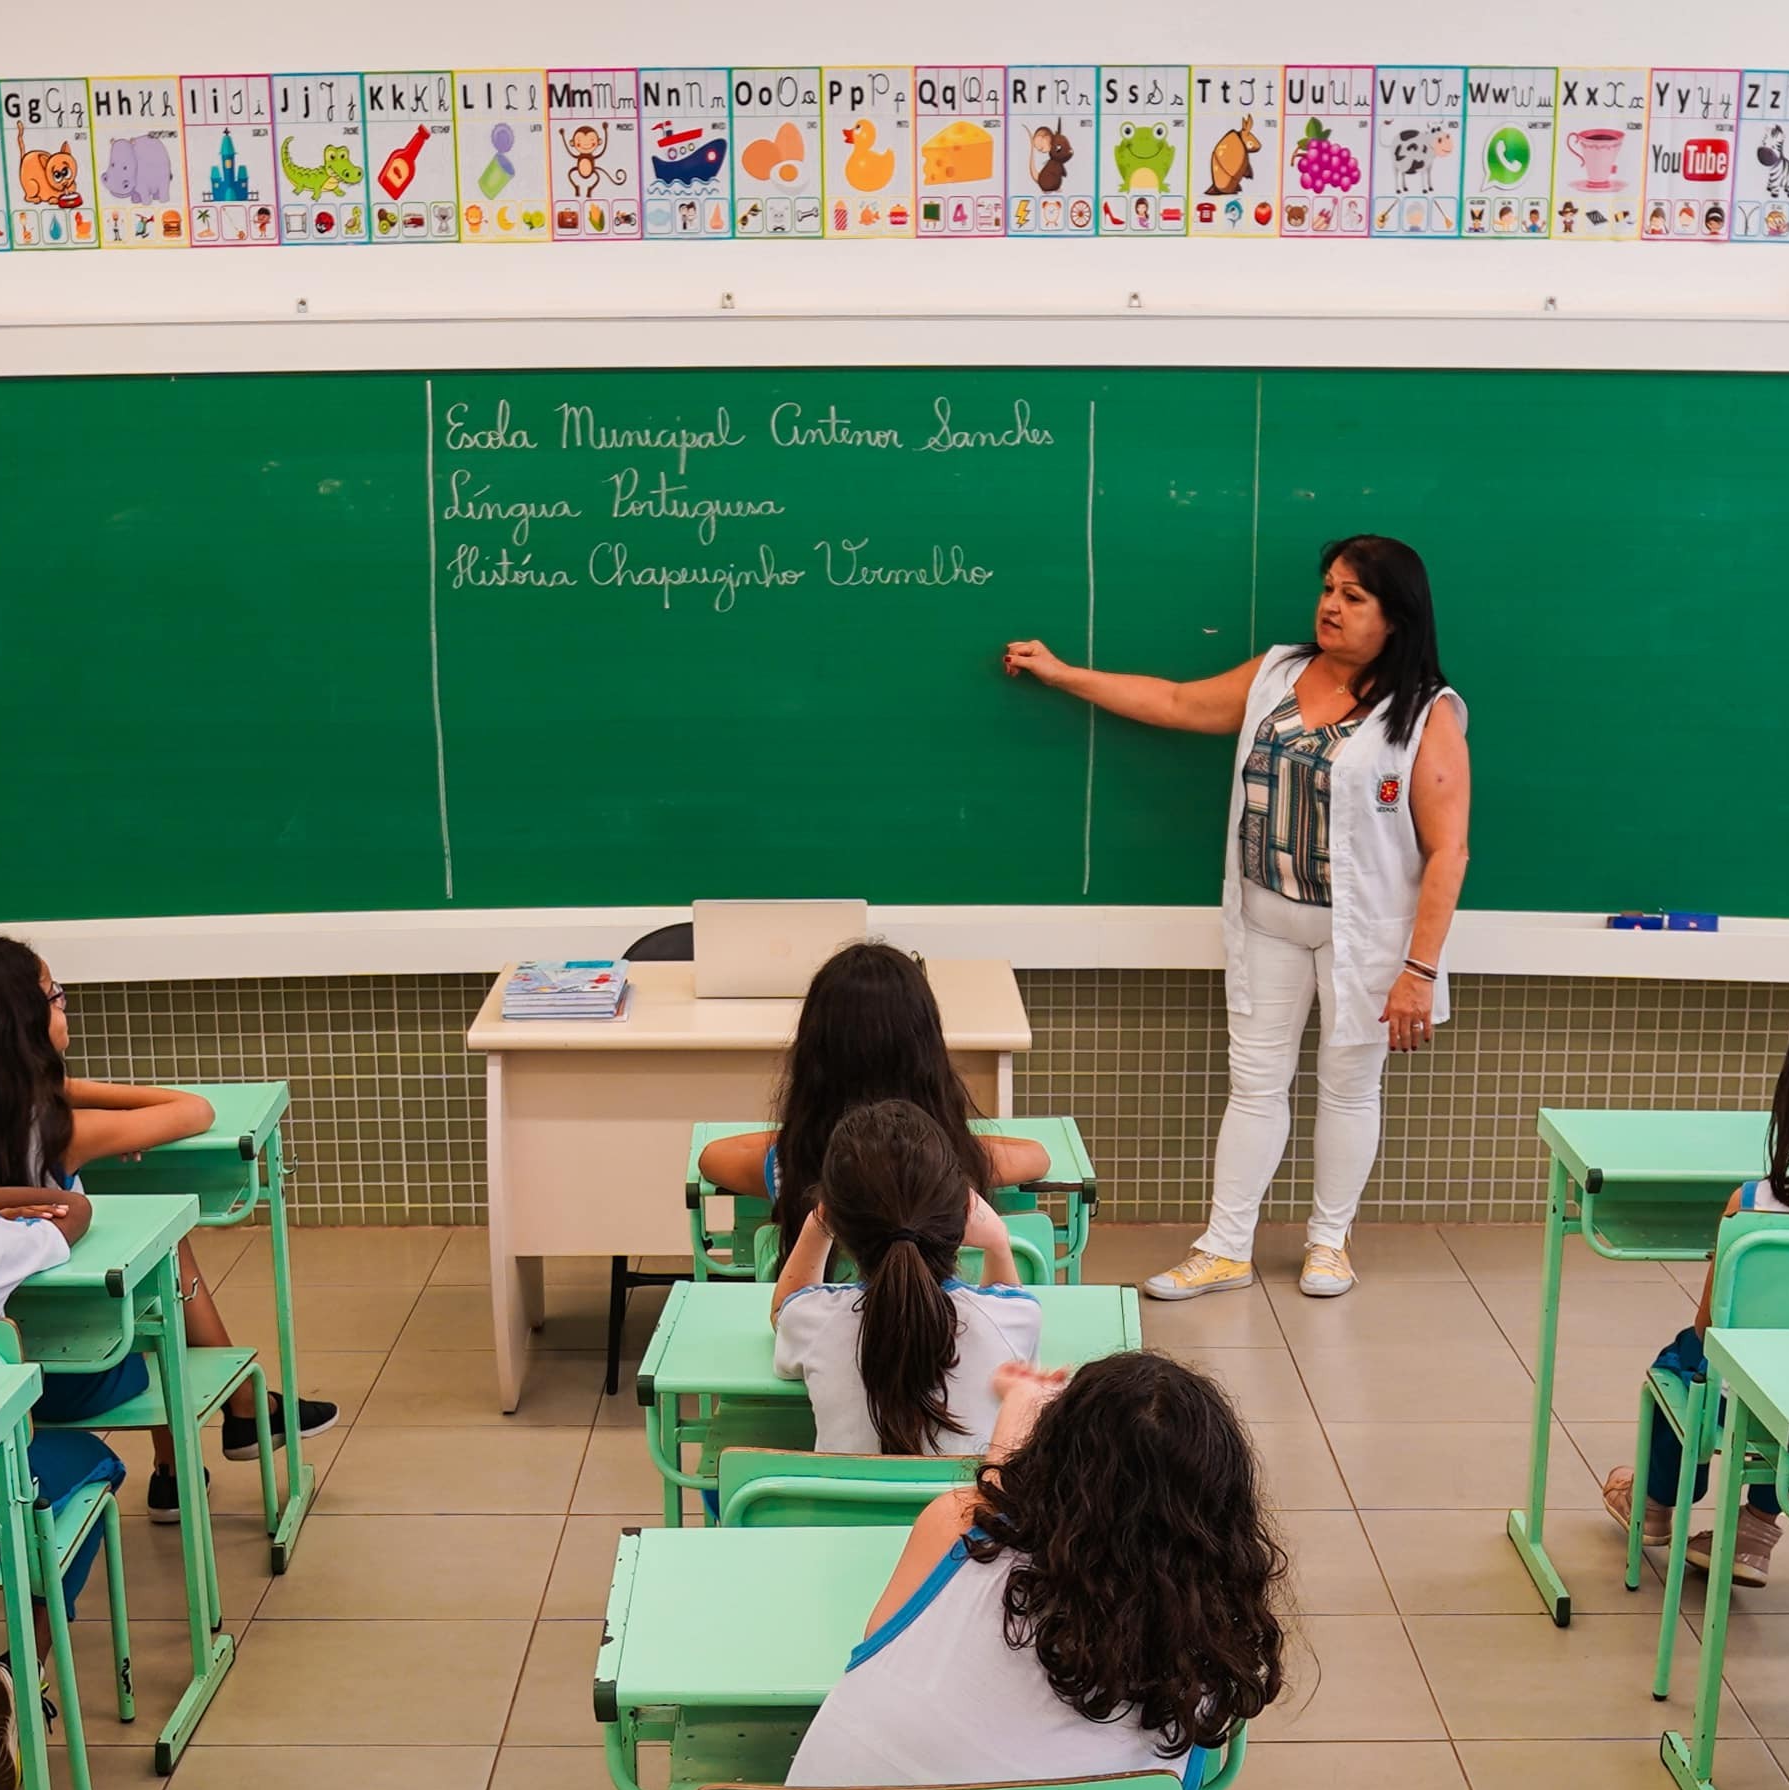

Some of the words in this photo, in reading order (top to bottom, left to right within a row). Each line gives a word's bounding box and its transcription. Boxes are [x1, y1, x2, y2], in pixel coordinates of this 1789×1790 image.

[1652, 143, 1728, 175] YouTube
[445, 399, 538, 450] Escola
[556, 402, 746, 475] Municipal
[770, 402, 903, 449] Antenor
[913, 396, 1054, 452] Sanches
[443, 469, 582, 546] Língua
[610, 467, 785, 546] Portuguesa
[446, 543, 578, 589] História
[589, 542, 807, 613] Chapeuzinho
[814, 538, 994, 588] Vermelho
